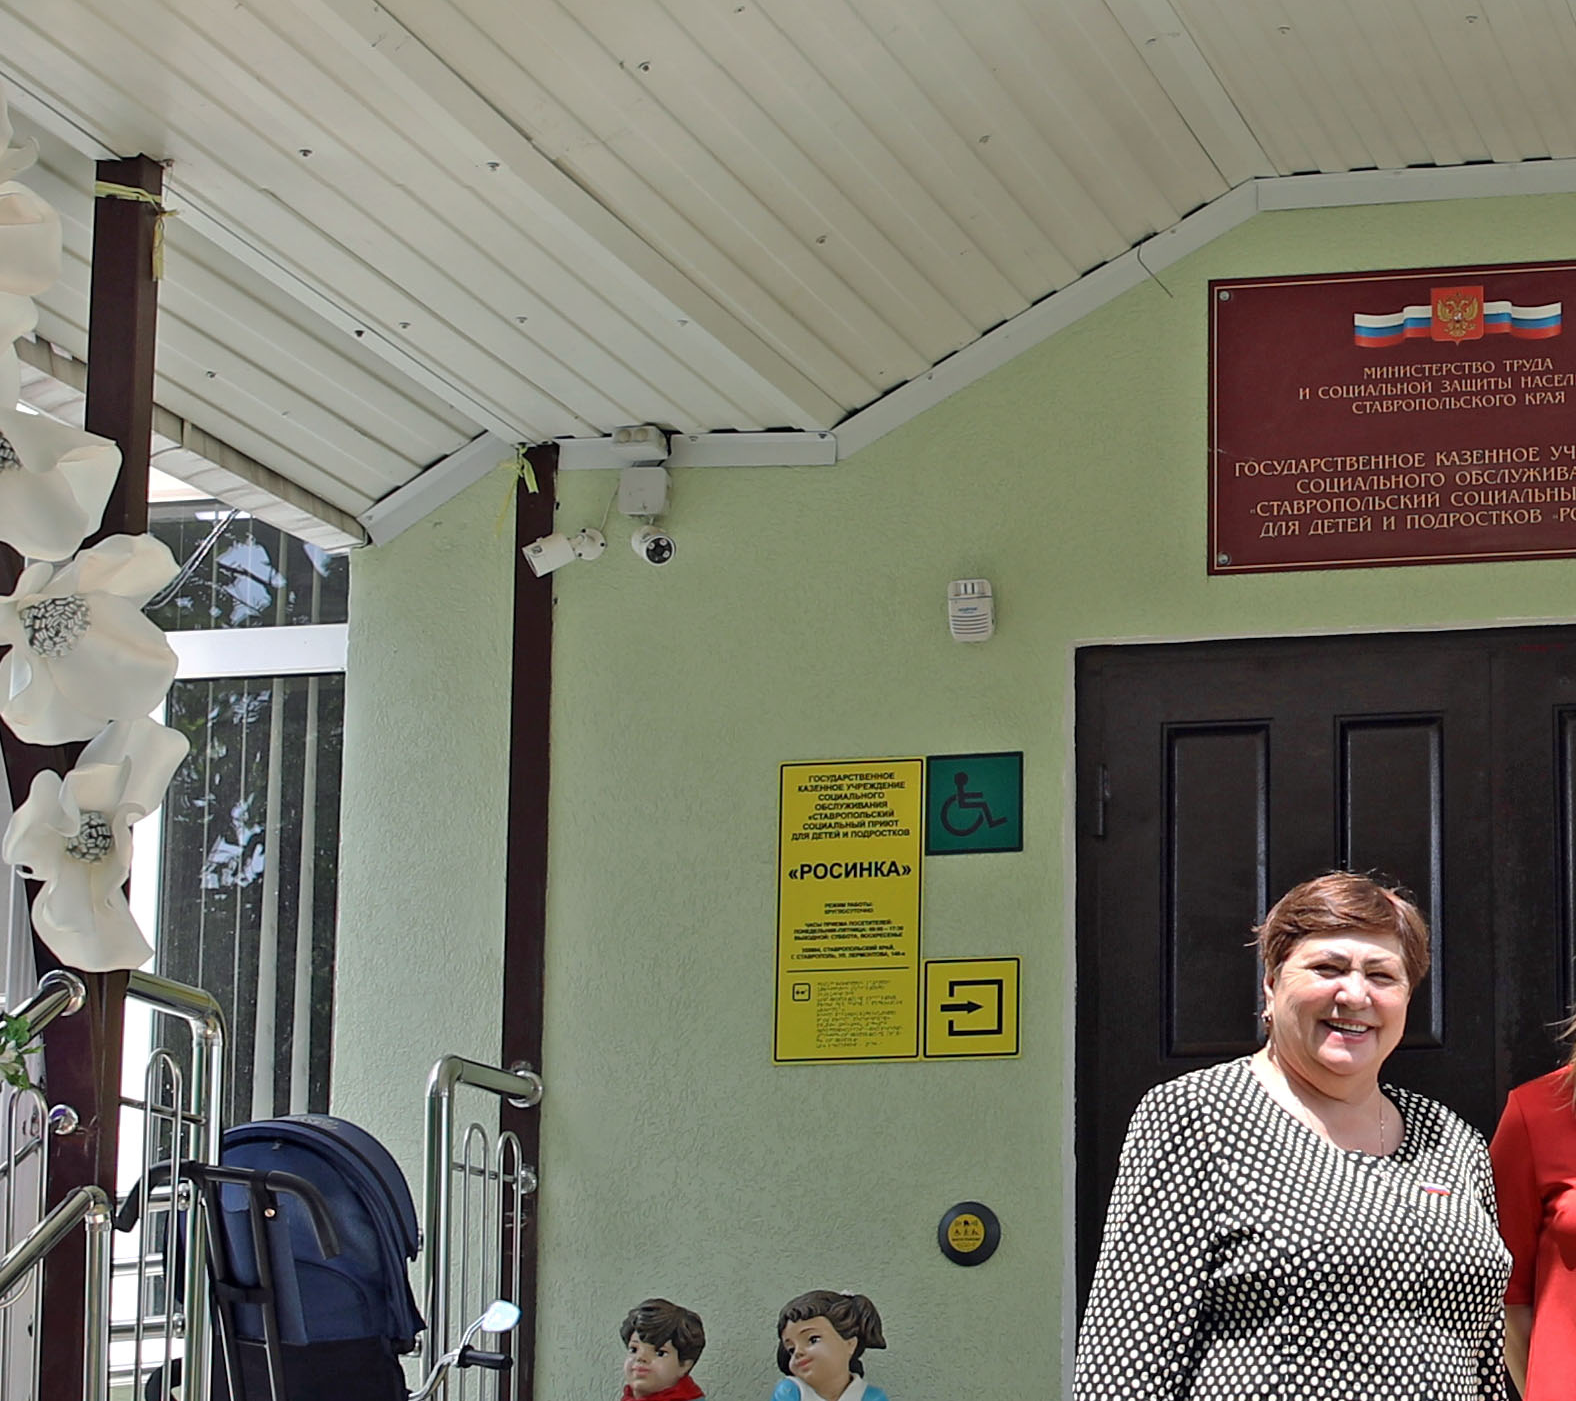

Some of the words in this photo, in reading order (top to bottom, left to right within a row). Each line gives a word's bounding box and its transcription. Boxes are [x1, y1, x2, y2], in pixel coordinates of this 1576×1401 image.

[1363, 360, 1496, 380] МИНИСТЕРСТВО
[1503, 357, 1554, 373] ТРУДА
[1299, 387, 1310, 401] И
[1317, 379, 1433, 400] СОЦИАЛЬНОЙ
[1440, 376, 1512, 393] ЗАЩИТЫ
[1351, 393, 1517, 415] СТАВРОПОЛЬСКОГО
[1524, 390, 1565, 406] КРАЯ
[1235, 453, 1426, 477] ГОСУДАРСТВЕННОЕ
[1435, 446, 1540, 467] КАЗЕННОЕ
[1296, 471, 1446, 494] СОЦИАЛЬНОГО
[1250, 491, 1440, 517] «СТАВРОПОЛЬСКИЙ
[1259, 520, 1300, 539] ДЛЯ
[1307, 515, 1372, 536] ДЕТЕЙ
[1382, 515, 1396, 531] И
[1406, 508, 1543, 530] ПОДРОСТКОВ
[797, 783, 843, 793] КАЗЕННОЕ
[846, 781, 905, 791] УЧРЕЖДЕНИЕ
[808, 772, 895, 783] ГОСУДАРСТВЕННОЕ
[814, 801, 888, 812] ОБСЛУЖИВАНИЯ
[817, 792, 884, 802] СОЦИАЛЬНОГО
[807, 810, 894, 821] «СТАВРОПОЛЬСКИЙ
[802, 821, 865, 831] СОЦИАЛЬНЫЙ
[867, 820, 899, 829] ПРИЮТ
[790, 833, 809, 842] ДЛЯ
[811, 831, 840, 841] ДЕТЕЙ
[842, 831, 848, 839] И
[850, 829, 910, 839] ПОДРОСТКОВ
[788, 861, 912, 880] «РОСИНКА»
